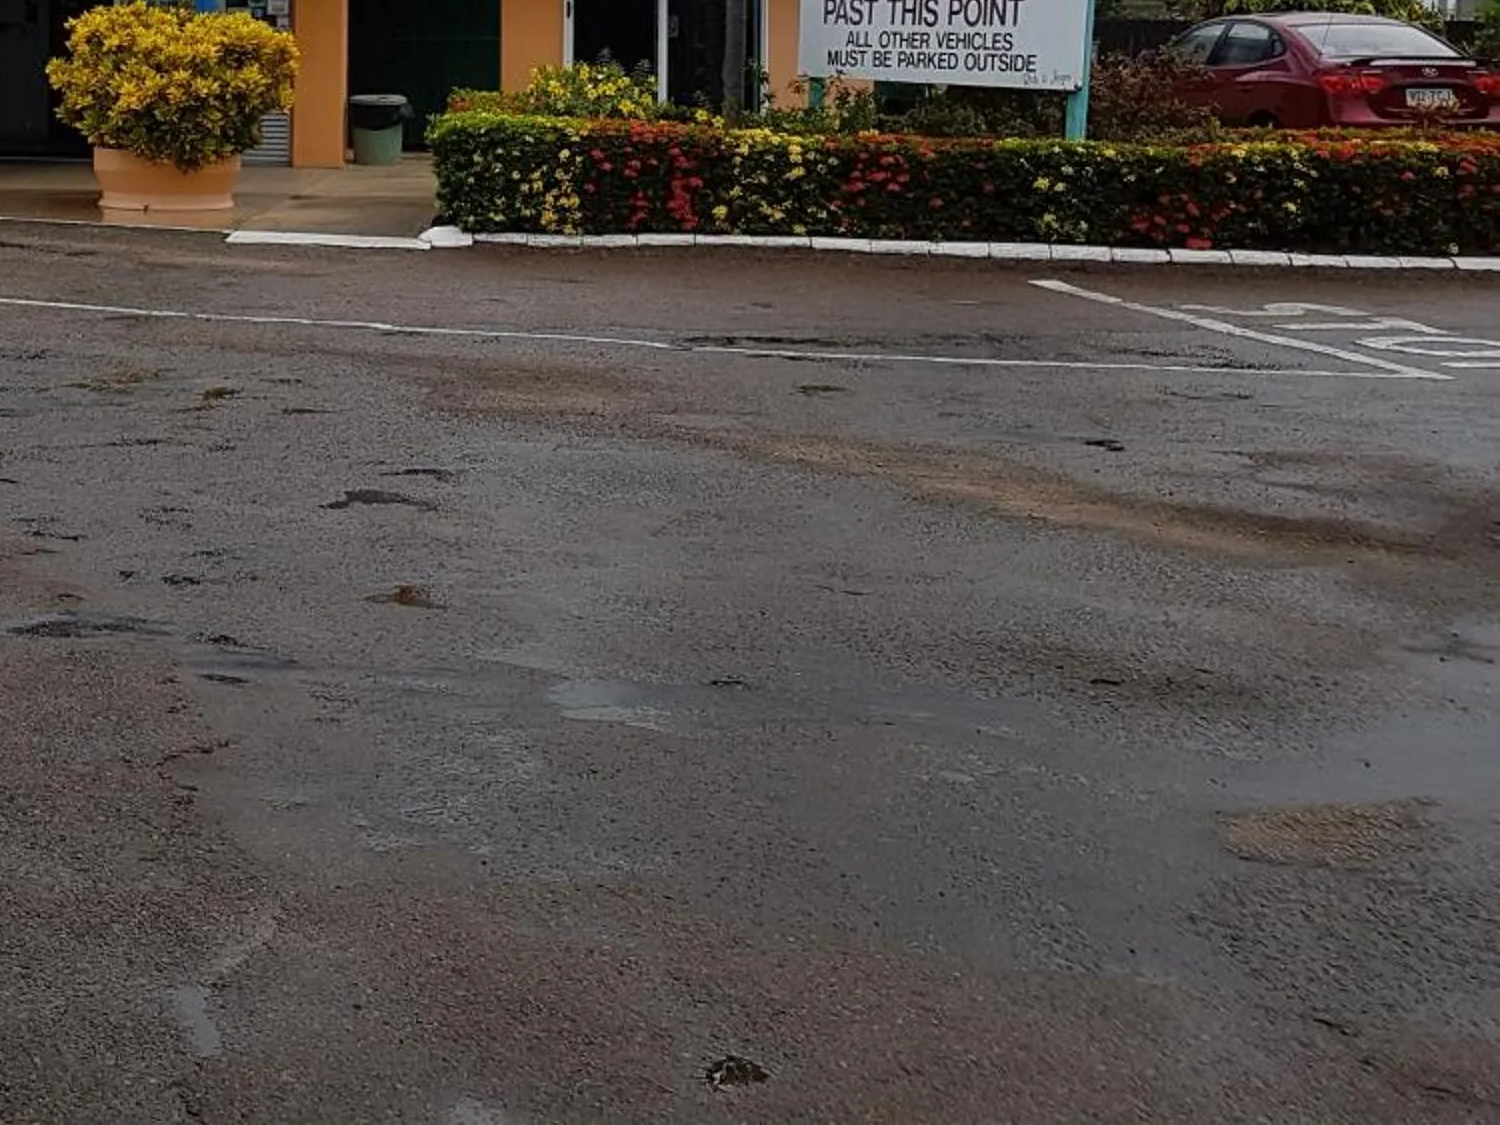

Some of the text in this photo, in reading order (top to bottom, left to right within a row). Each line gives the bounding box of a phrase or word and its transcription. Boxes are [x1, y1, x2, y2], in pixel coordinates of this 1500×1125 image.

[846, 33, 1013, 50] ALL OTHER VEHICLES
[828, 51, 1037, 72] MUST BE PARKED OUTSIDE
